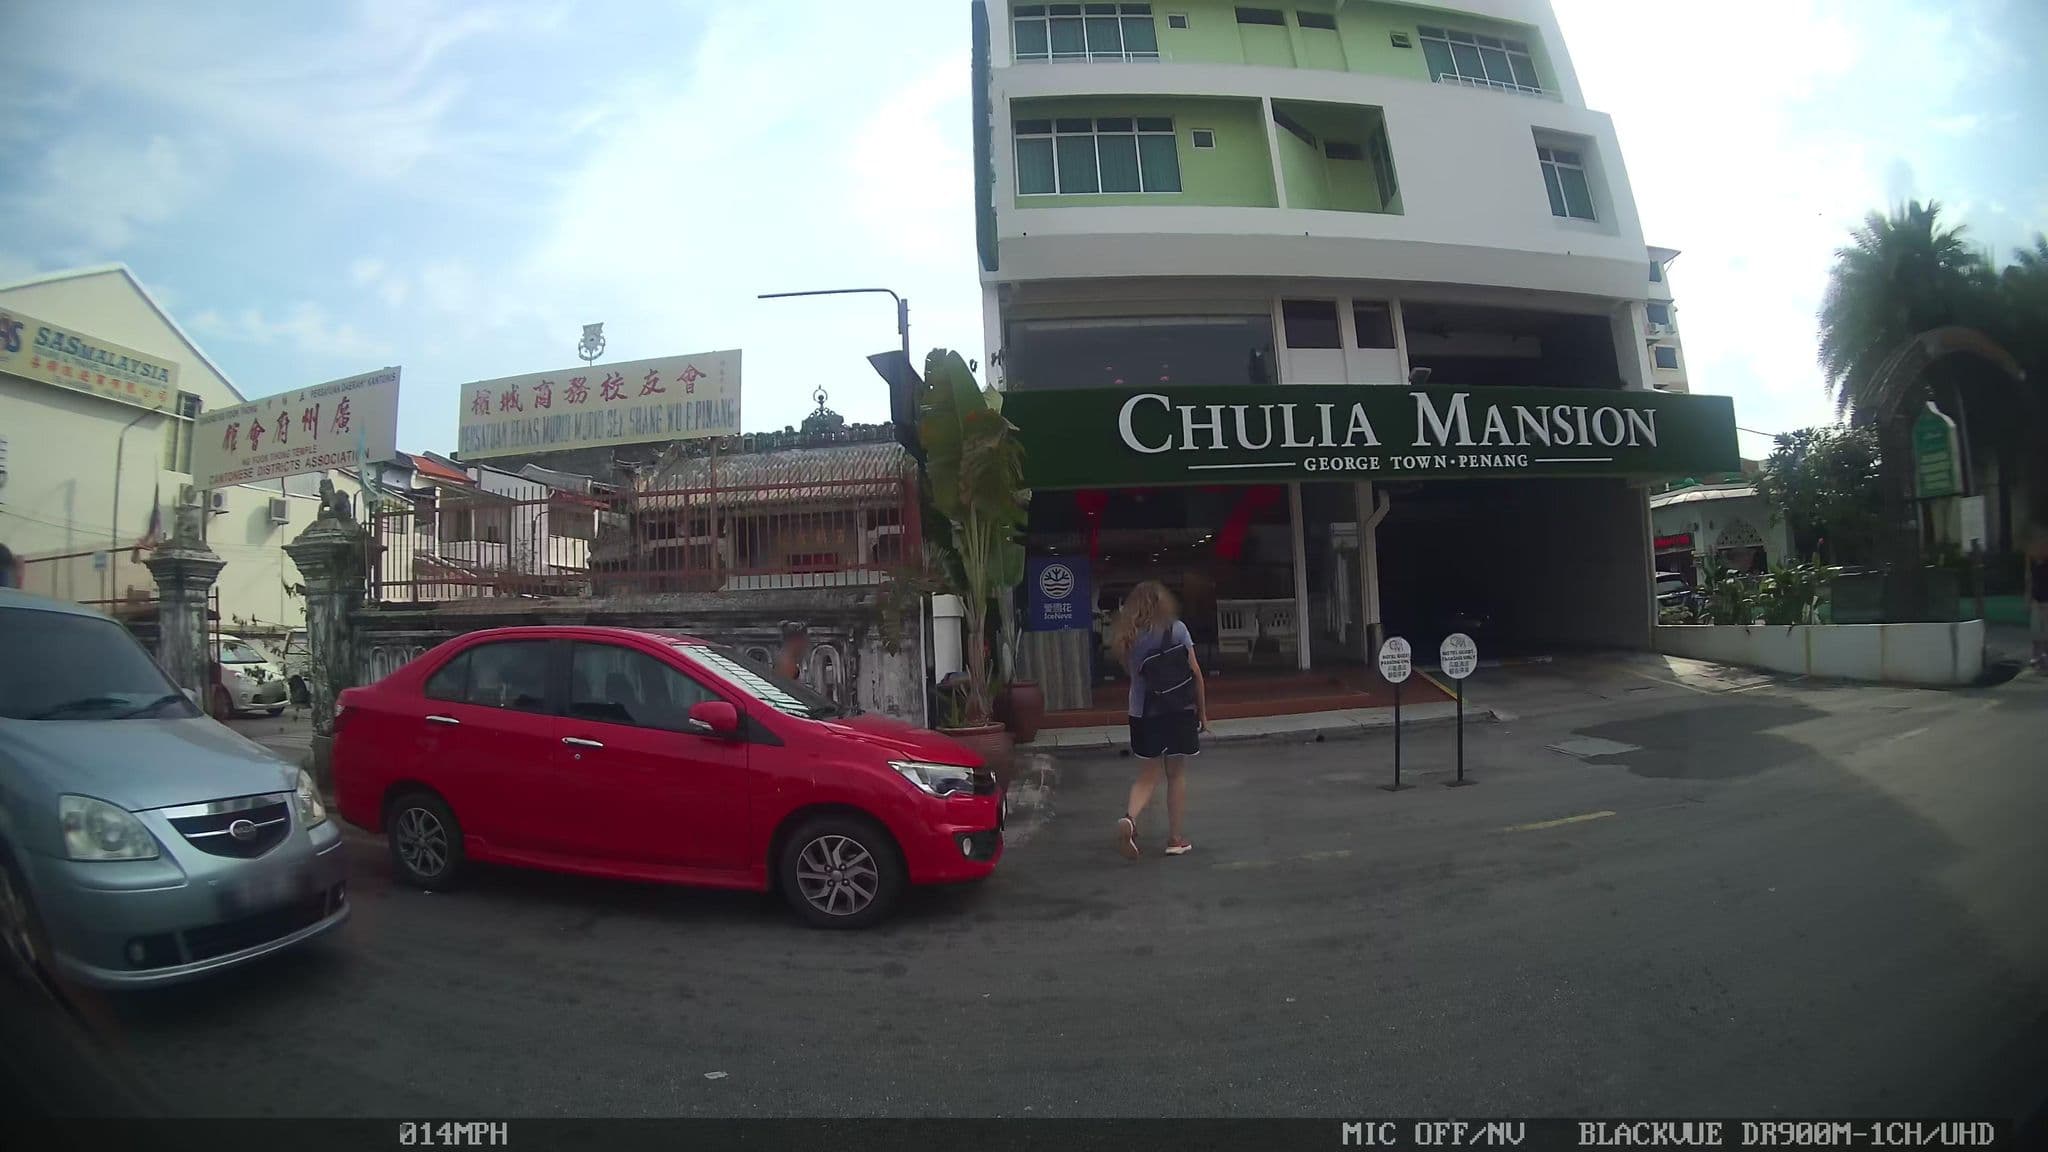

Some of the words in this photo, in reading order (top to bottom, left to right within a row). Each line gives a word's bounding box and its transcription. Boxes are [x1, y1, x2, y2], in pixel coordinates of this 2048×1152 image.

[1118, 393, 1381, 453] CHULIA
[1410, 392, 1659, 449] MANSION
[257, 459, 300, 476] DISTRICTS
[305, 447, 369, 468] ASSOCIATIN
[1303, 456, 1380, 471] GEORGE
